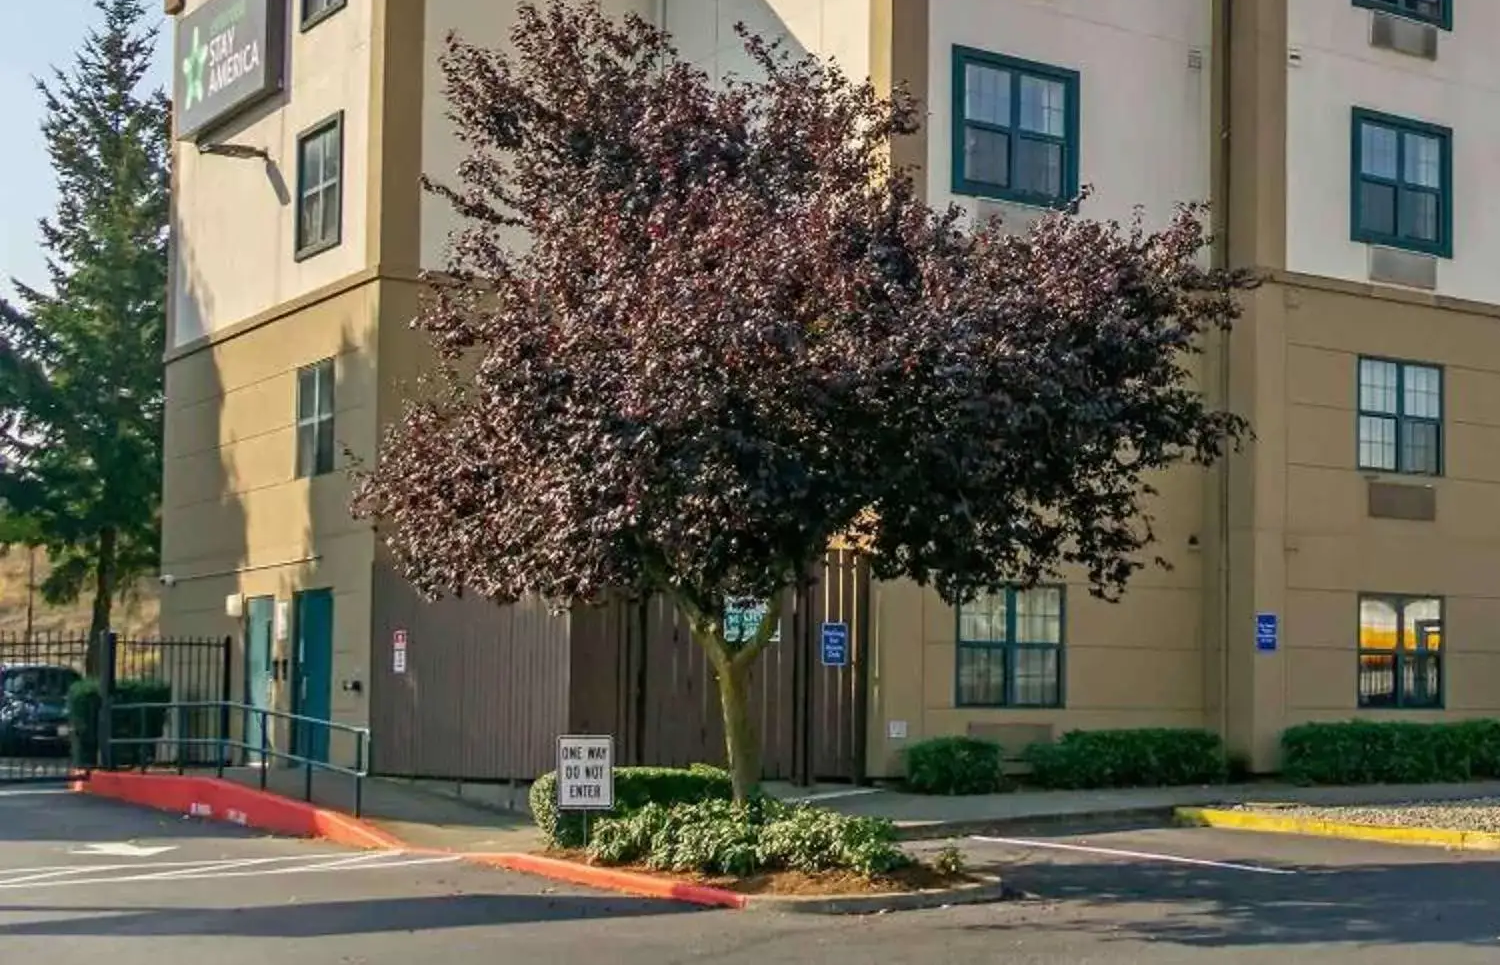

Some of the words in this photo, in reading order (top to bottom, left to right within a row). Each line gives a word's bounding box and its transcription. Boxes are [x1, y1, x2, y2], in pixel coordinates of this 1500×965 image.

[208, 25, 235, 67] STAY
[208, 40, 260, 98] AMERICA
[562, 746, 582, 760] ONE
[587, 746, 607, 760] WAY
[566, 765, 580, 780] DO
[585, 765, 604, 780] NOT
[569, 784, 601, 798] ENTER
